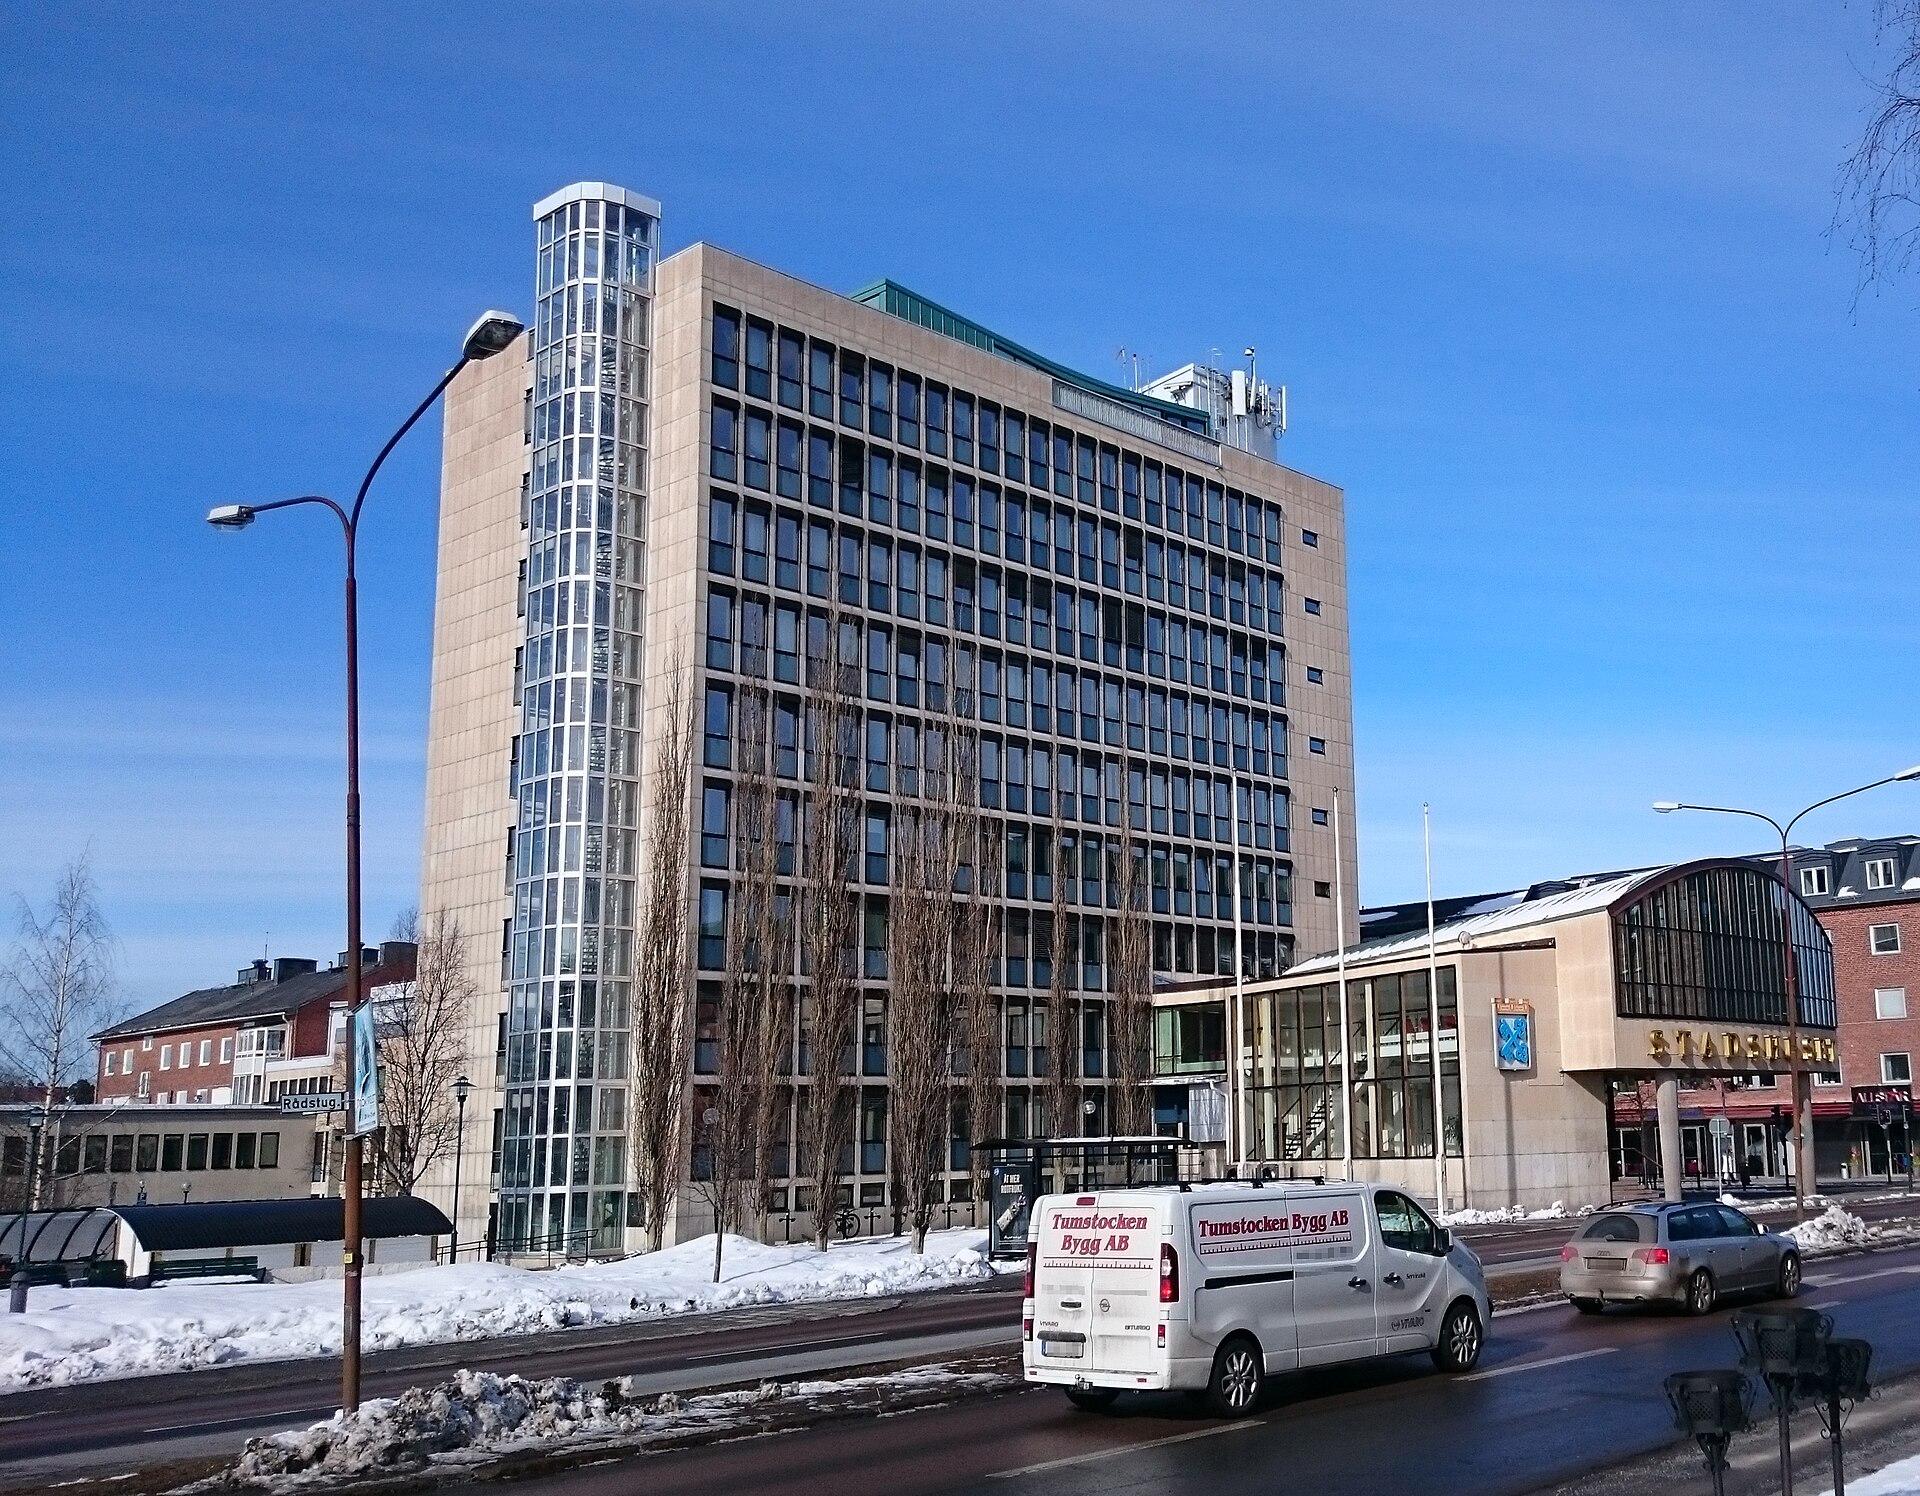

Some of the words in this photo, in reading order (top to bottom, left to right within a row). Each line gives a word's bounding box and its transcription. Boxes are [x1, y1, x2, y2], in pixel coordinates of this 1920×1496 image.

[283, 1098, 340, 1110] Rådstug.
[1053, 1213, 1147, 1230] Tumstocken
[1198, 1216, 1289, 1237] Tumstocken
[1291, 1213, 1327, 1232] Bygg
[1330, 1210, 1349, 1226] AB
[1061, 1235, 1102, 1255] Bygg
[1104, 1235, 1129, 1251] AB
